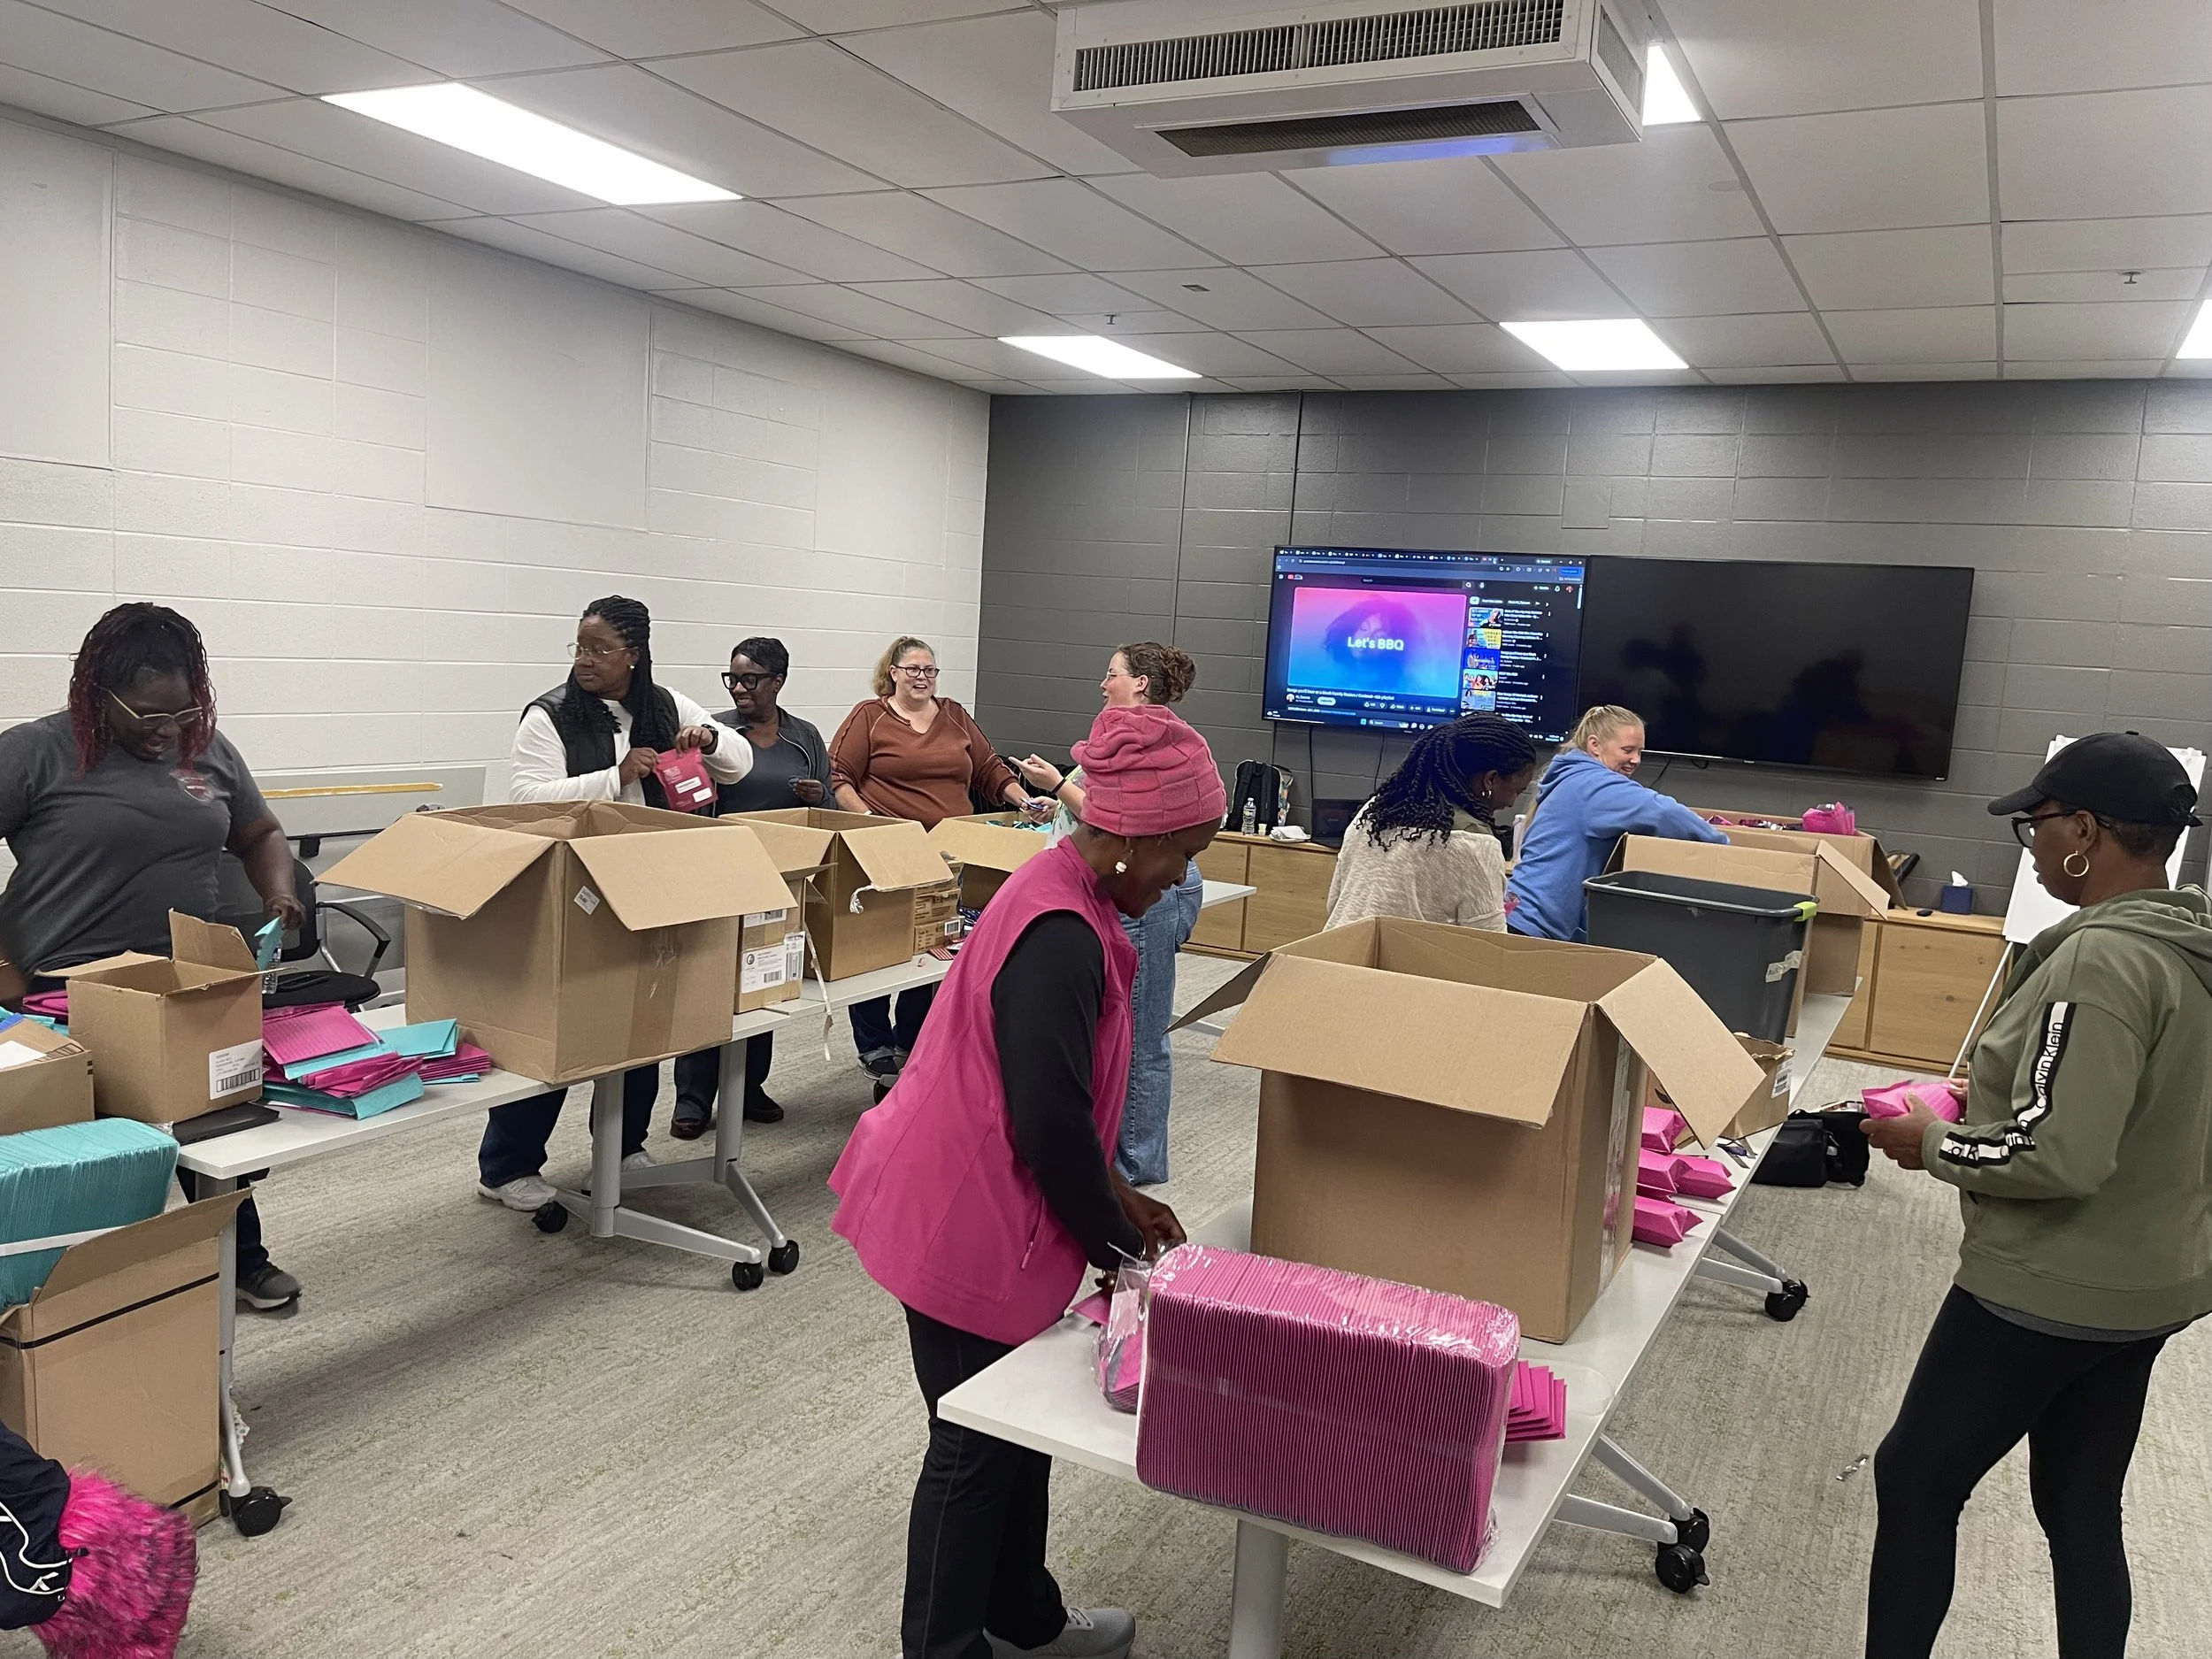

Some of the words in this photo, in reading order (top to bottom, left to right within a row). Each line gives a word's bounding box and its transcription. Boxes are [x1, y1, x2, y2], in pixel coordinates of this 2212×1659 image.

[1348, 637, 1375, 649] Let's
[1378, 638, 1404, 651] BBQ
[2043, 1022, 2063, 1057] Klein
